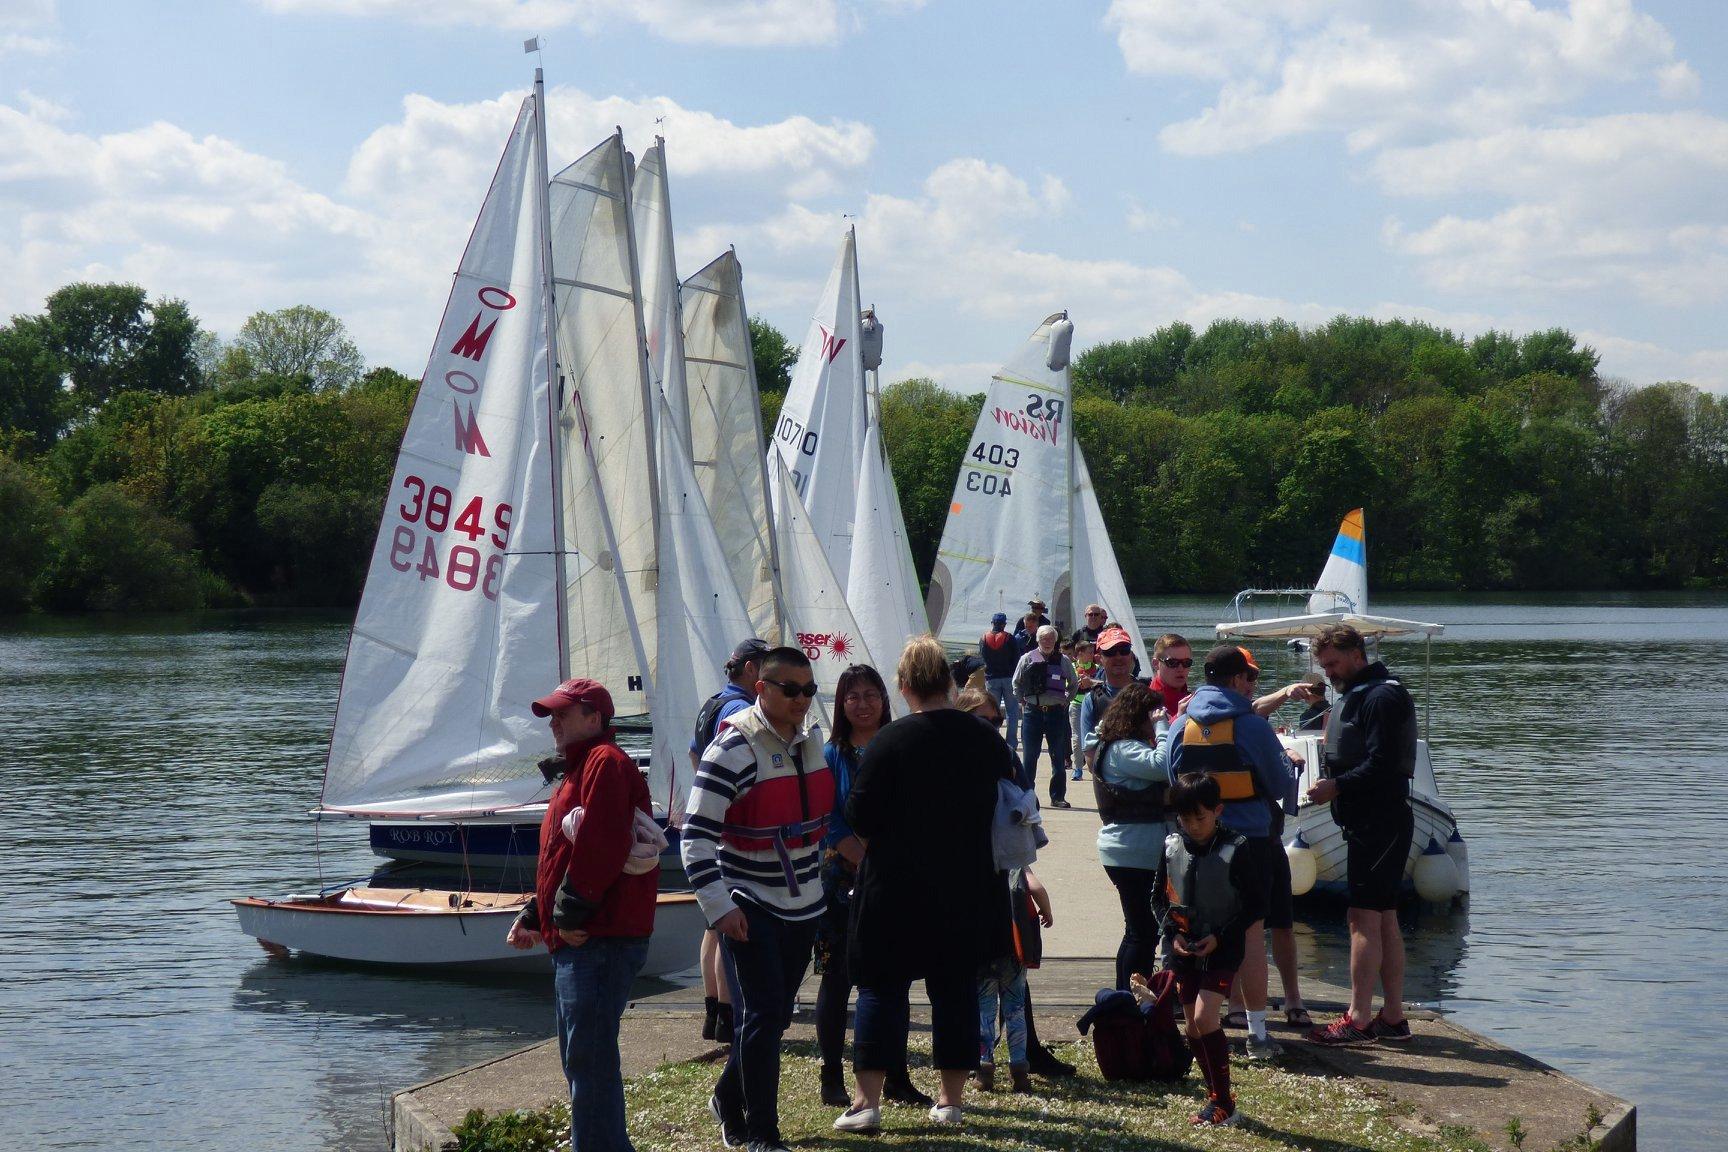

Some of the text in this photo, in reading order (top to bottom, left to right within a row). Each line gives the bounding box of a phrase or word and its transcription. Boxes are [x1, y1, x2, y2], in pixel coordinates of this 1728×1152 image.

[777, 415, 817, 456] 10710
[972, 442, 1019, 468] 403
[400, 475, 512, 550] 3849
[796, 633, 831, 645] aser
[390, 828, 456, 846] ROB ROY
